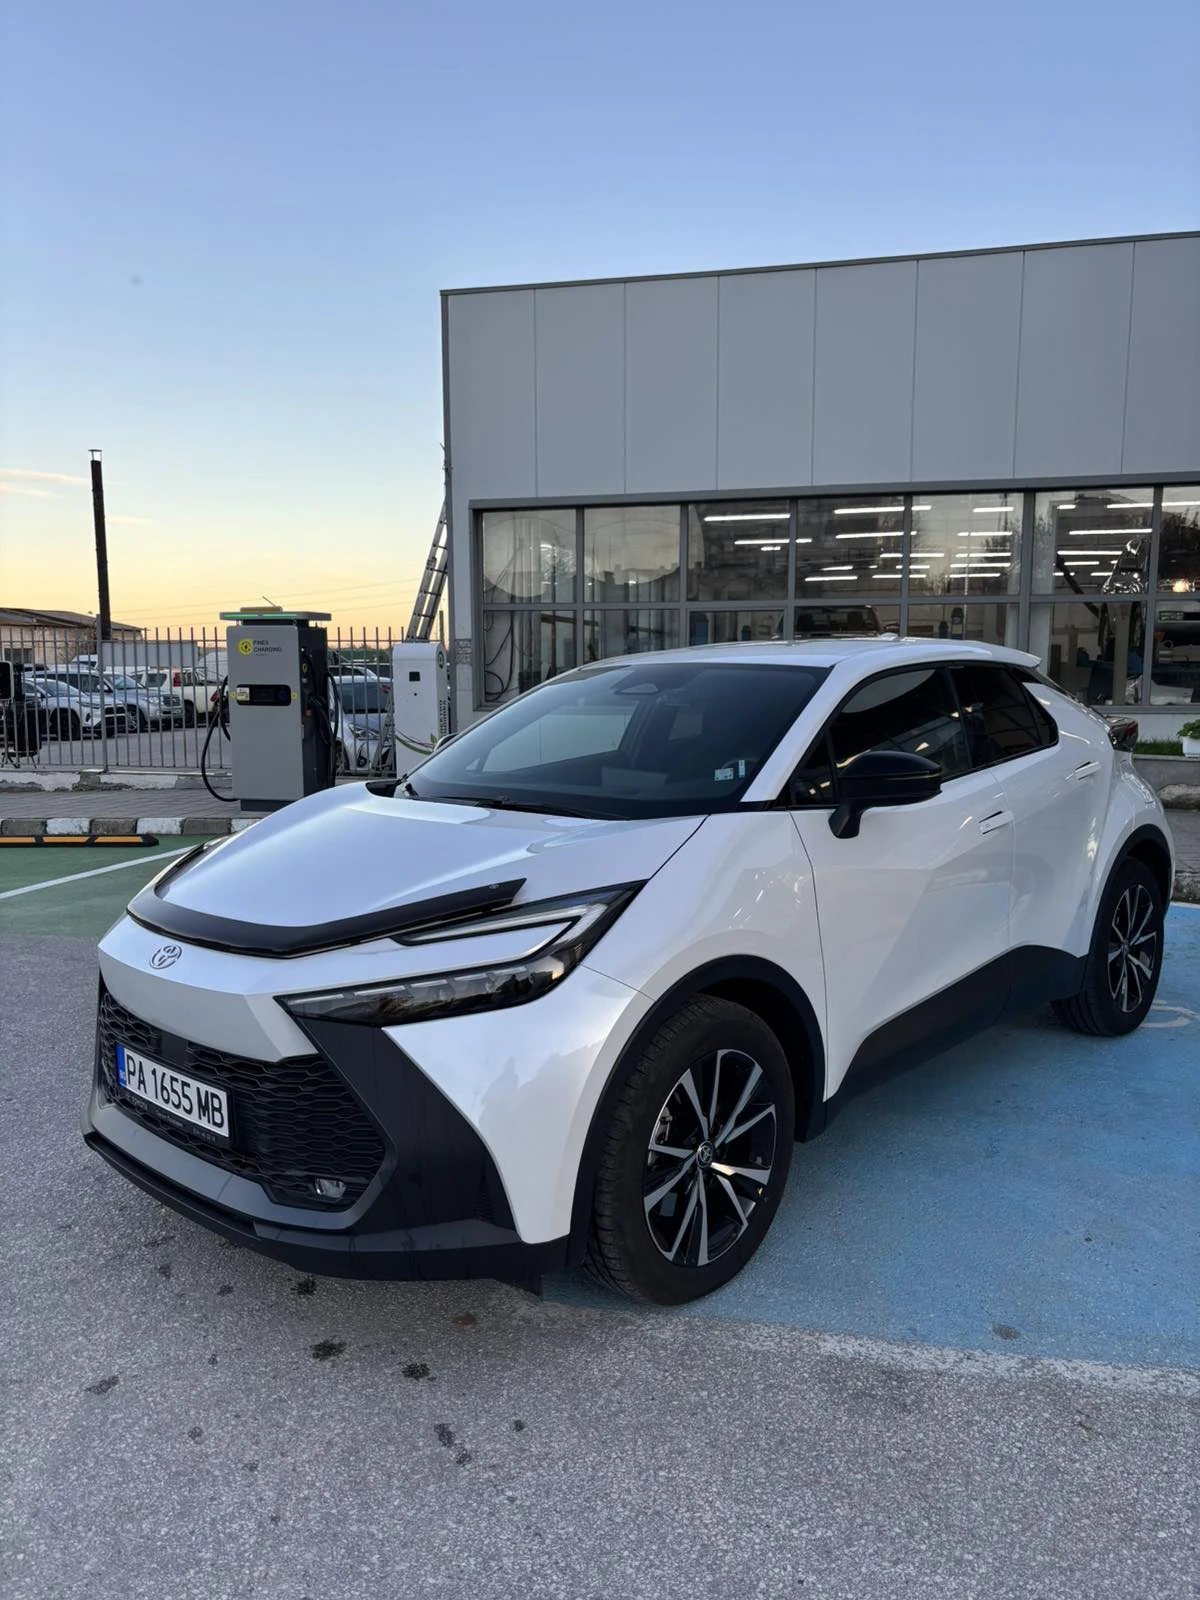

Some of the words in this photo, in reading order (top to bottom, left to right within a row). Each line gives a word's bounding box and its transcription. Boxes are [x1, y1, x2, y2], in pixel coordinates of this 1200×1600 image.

[126, 1053, 147, 1095] PA
[151, 1067, 194, 1116] 1655
[196, 1086, 224, 1129] MB
